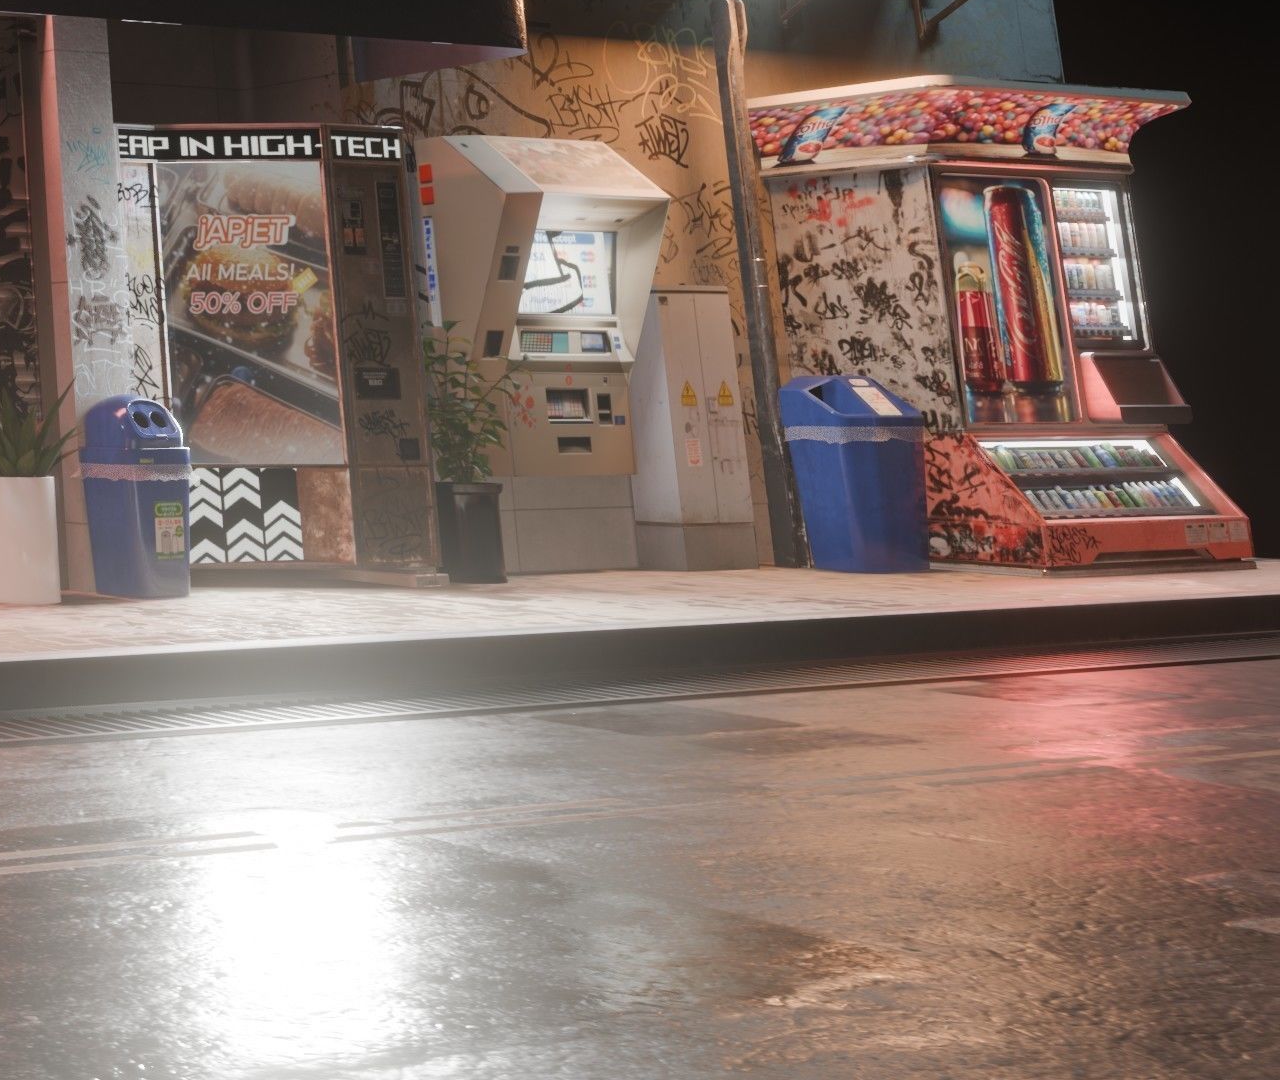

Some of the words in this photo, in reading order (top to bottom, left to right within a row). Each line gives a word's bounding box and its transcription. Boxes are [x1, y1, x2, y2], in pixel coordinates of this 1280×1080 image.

[180, 136, 215, 156] IN
[218, 263, 295, 281] MEALS!
[190, 291, 242, 315] 50%
[247, 290, 299, 314] OFF
